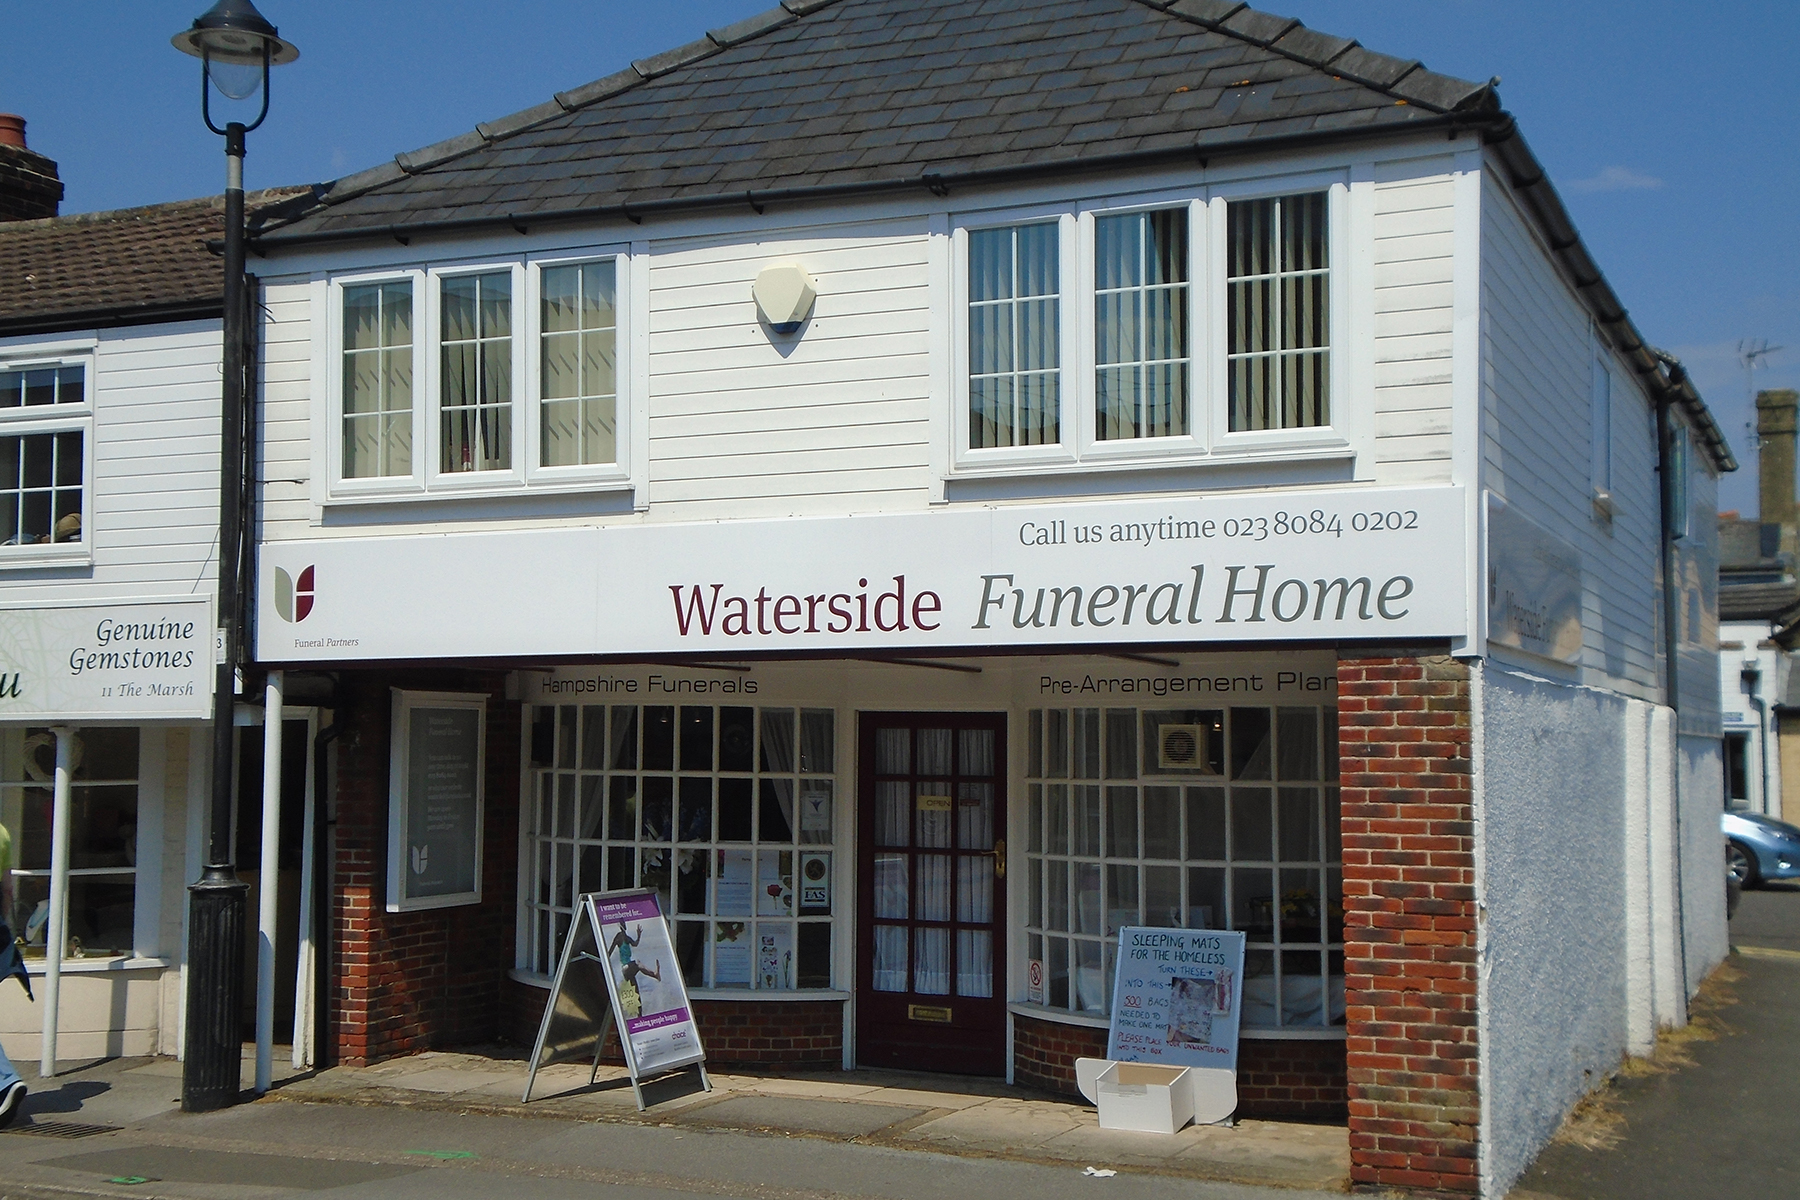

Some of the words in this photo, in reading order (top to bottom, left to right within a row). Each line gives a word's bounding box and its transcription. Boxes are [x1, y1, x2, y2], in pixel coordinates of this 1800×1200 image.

[1018, 519, 1066, 547] Call
[1072, 523, 1102, 544] us
[1109, 514, 1216, 547] anytime
[1222, 516, 1269, 542] 023
[1272, 509, 1344, 539] 8084
[1350, 509, 1420, 533] 0202
[668, 575, 943, 637] Waterside
[970, 562, 1205, 630] Funeral
[1221, 563, 1415, 625] Home
[96, 616, 195, 647] Genuine
[294, 638, 325, 648] Funeral
[326, 637, 360, 647] Partners
[69, 647, 195, 676] Gemstones
[117, 681, 143, 698] The
[146, 680, 195, 698] Marsh
[541, 675, 639, 697] Hampshire
[647, 674, 759, 694] Funerals
[1039, 673, 1264, 697] Pre-Arrangement
[602, 911, 632, 921] remembered
[1131, 933, 1185, 949] SLEEPING
[1191, 936, 1221, 950] MATS
[1130, 948, 1149, 960] FOR
[1152, 949, 1171, 961] THE
[1174, 951, 1226, 966] HOMELESS
[1157, 964, 1177, 974] TURN
[1181, 965, 1206, 976] THESE
[1124, 978, 1144, 988] INTO
[1147, 980, 1164, 990] THIS
[1147, 996, 1170, 1008] BAGS
[1120, 1010, 1151, 1020] NEEDED
[1151, 1012, 1161, 1020] TO
[1118, 1019, 1137, 1028] MAKE
[1138, 1020, 1153, 1030] ONE
[1117, 1031, 1144, 1044] PLEASE
[1145, 1035, 1162, 1045] PLACE
[1183, 1043, 1215, 1054] UNWANTED
